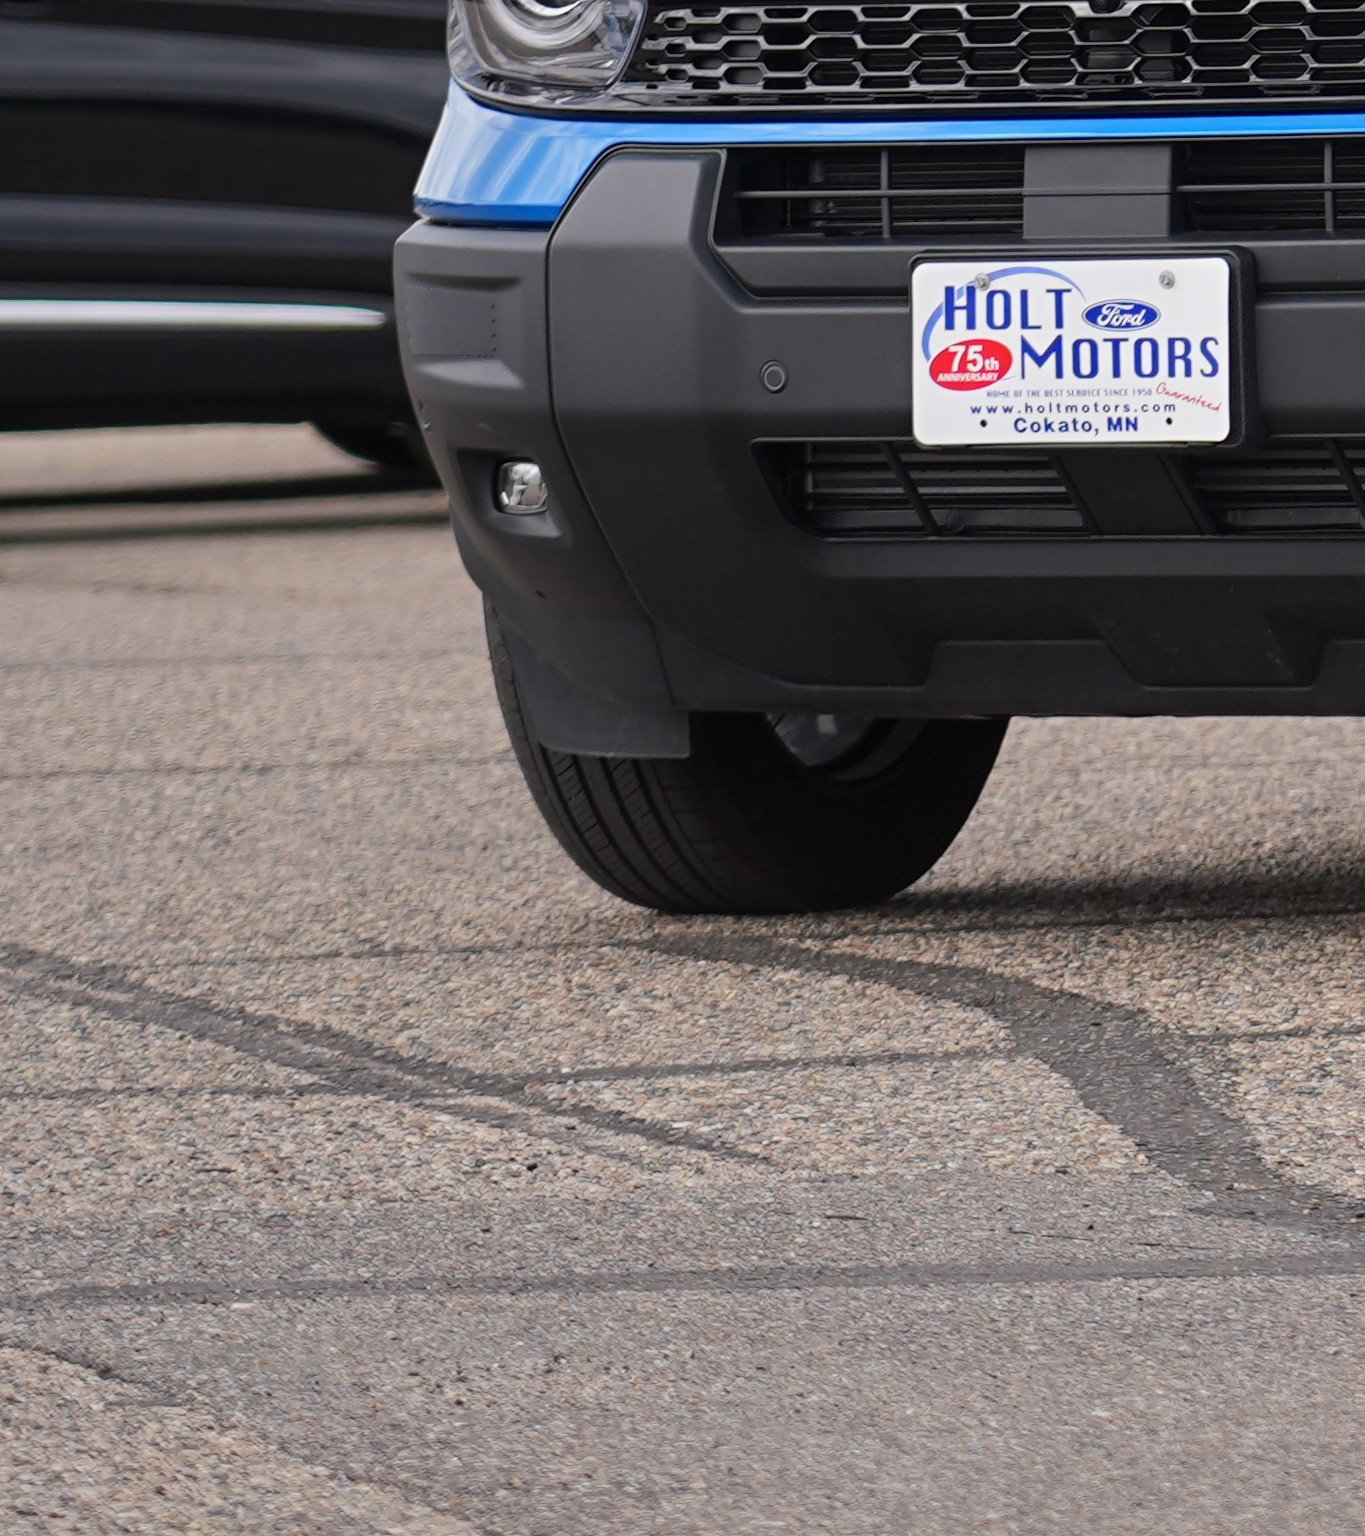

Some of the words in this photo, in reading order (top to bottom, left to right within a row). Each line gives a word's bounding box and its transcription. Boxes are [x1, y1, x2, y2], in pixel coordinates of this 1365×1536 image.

[945, 286, 1072, 330] HOLT
[1096, 303, 1146, 327] Ford
[948, 344, 999, 373] 75th
[1021, 334, 1219, 379] MOTORS
[936, 372, 1000, 383] ANNIVERSARY
[1027, 390, 1042, 398] THE
[1044, 389, 1063, 397] BEST
[1104, 389, 1128, 397] SINCE
[1156, 381, 1223, 412] Guaranteed
[970, 402, 1176, 414] www.holtmotors.com
[1013, 416, 1099, 435] Cokato,
[1107, 416, 1139, 432] MN
